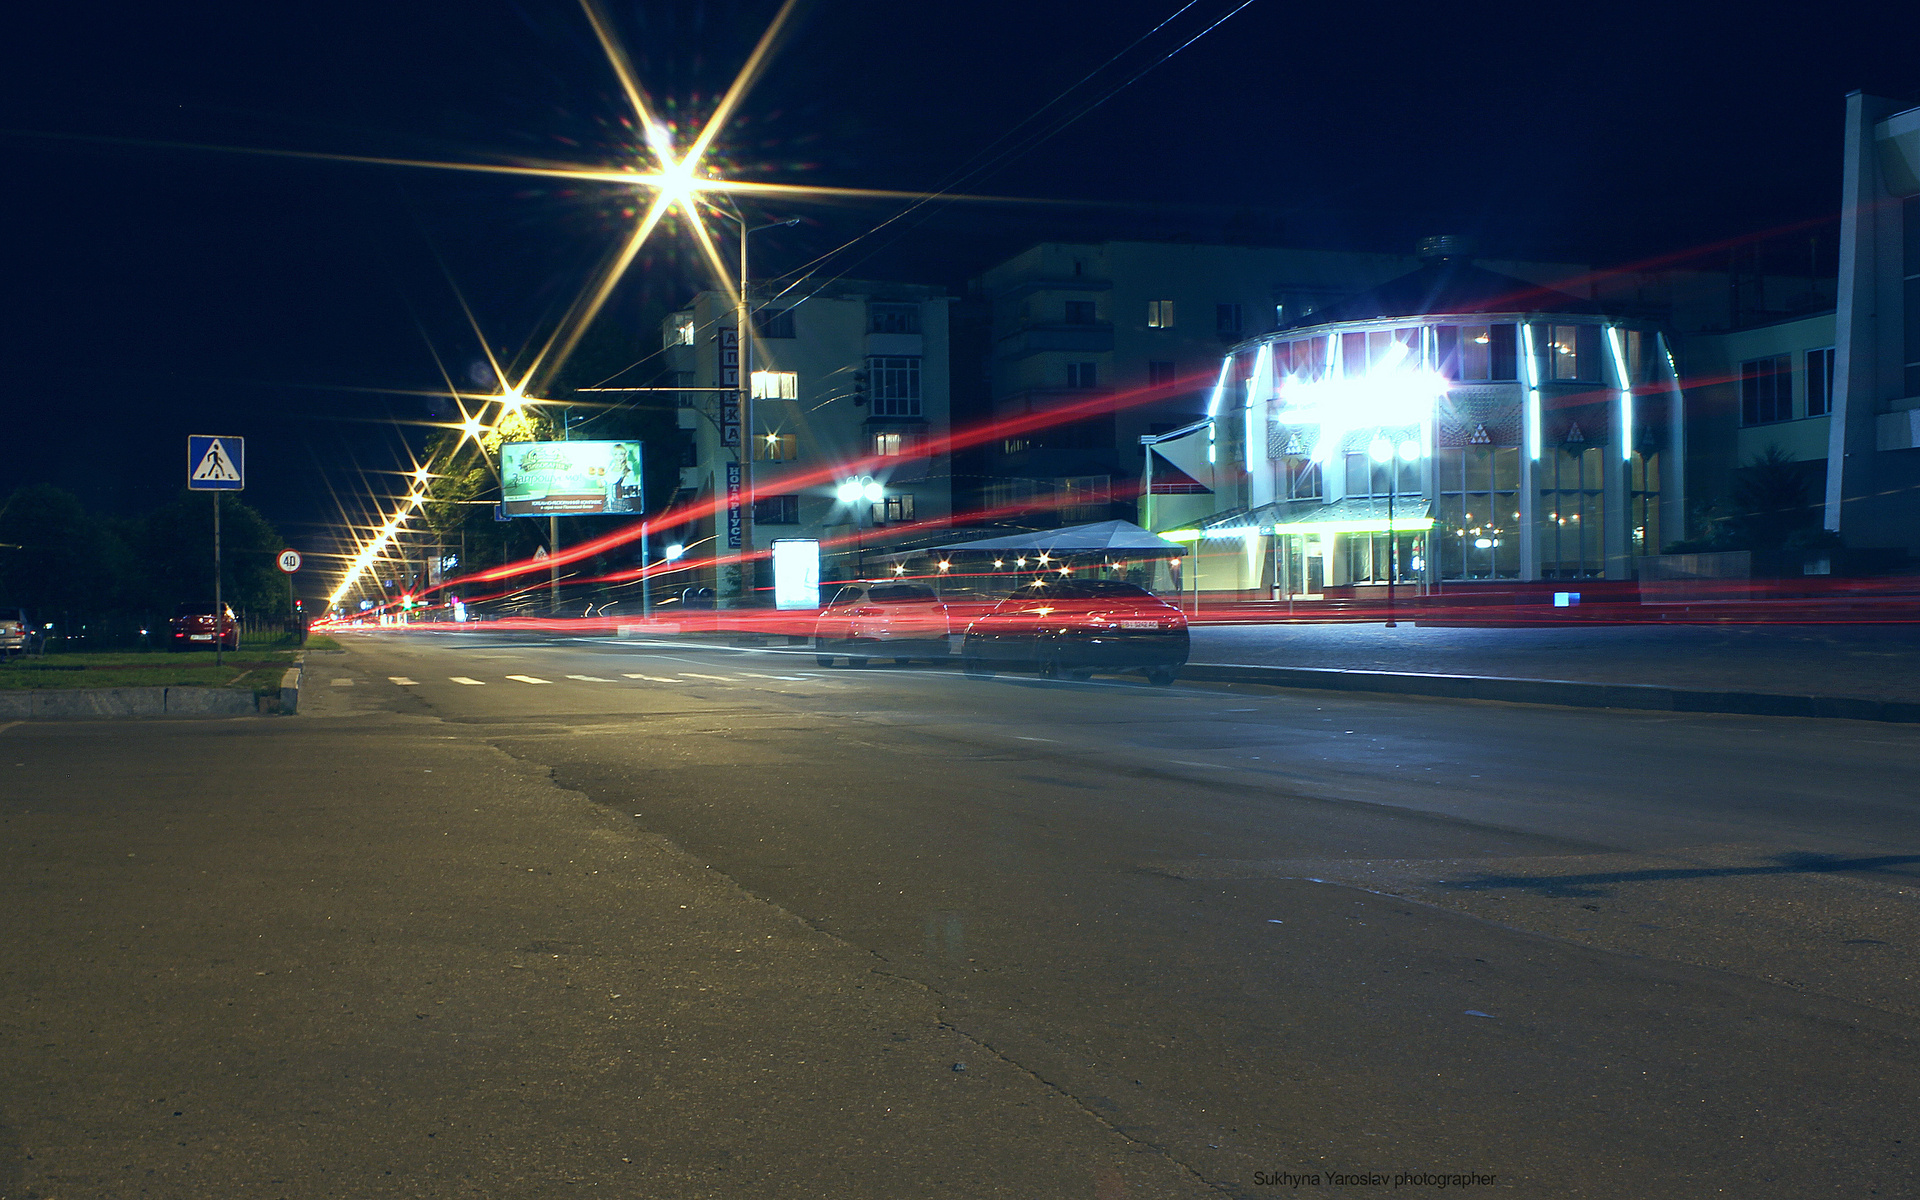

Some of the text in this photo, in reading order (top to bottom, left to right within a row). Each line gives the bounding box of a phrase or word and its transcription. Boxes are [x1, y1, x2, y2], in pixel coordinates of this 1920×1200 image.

[726, 332, 739, 440] АПТЕКА
[729, 466, 741, 535] НОТАРІУС
[283, 555, 296, 567] 40
